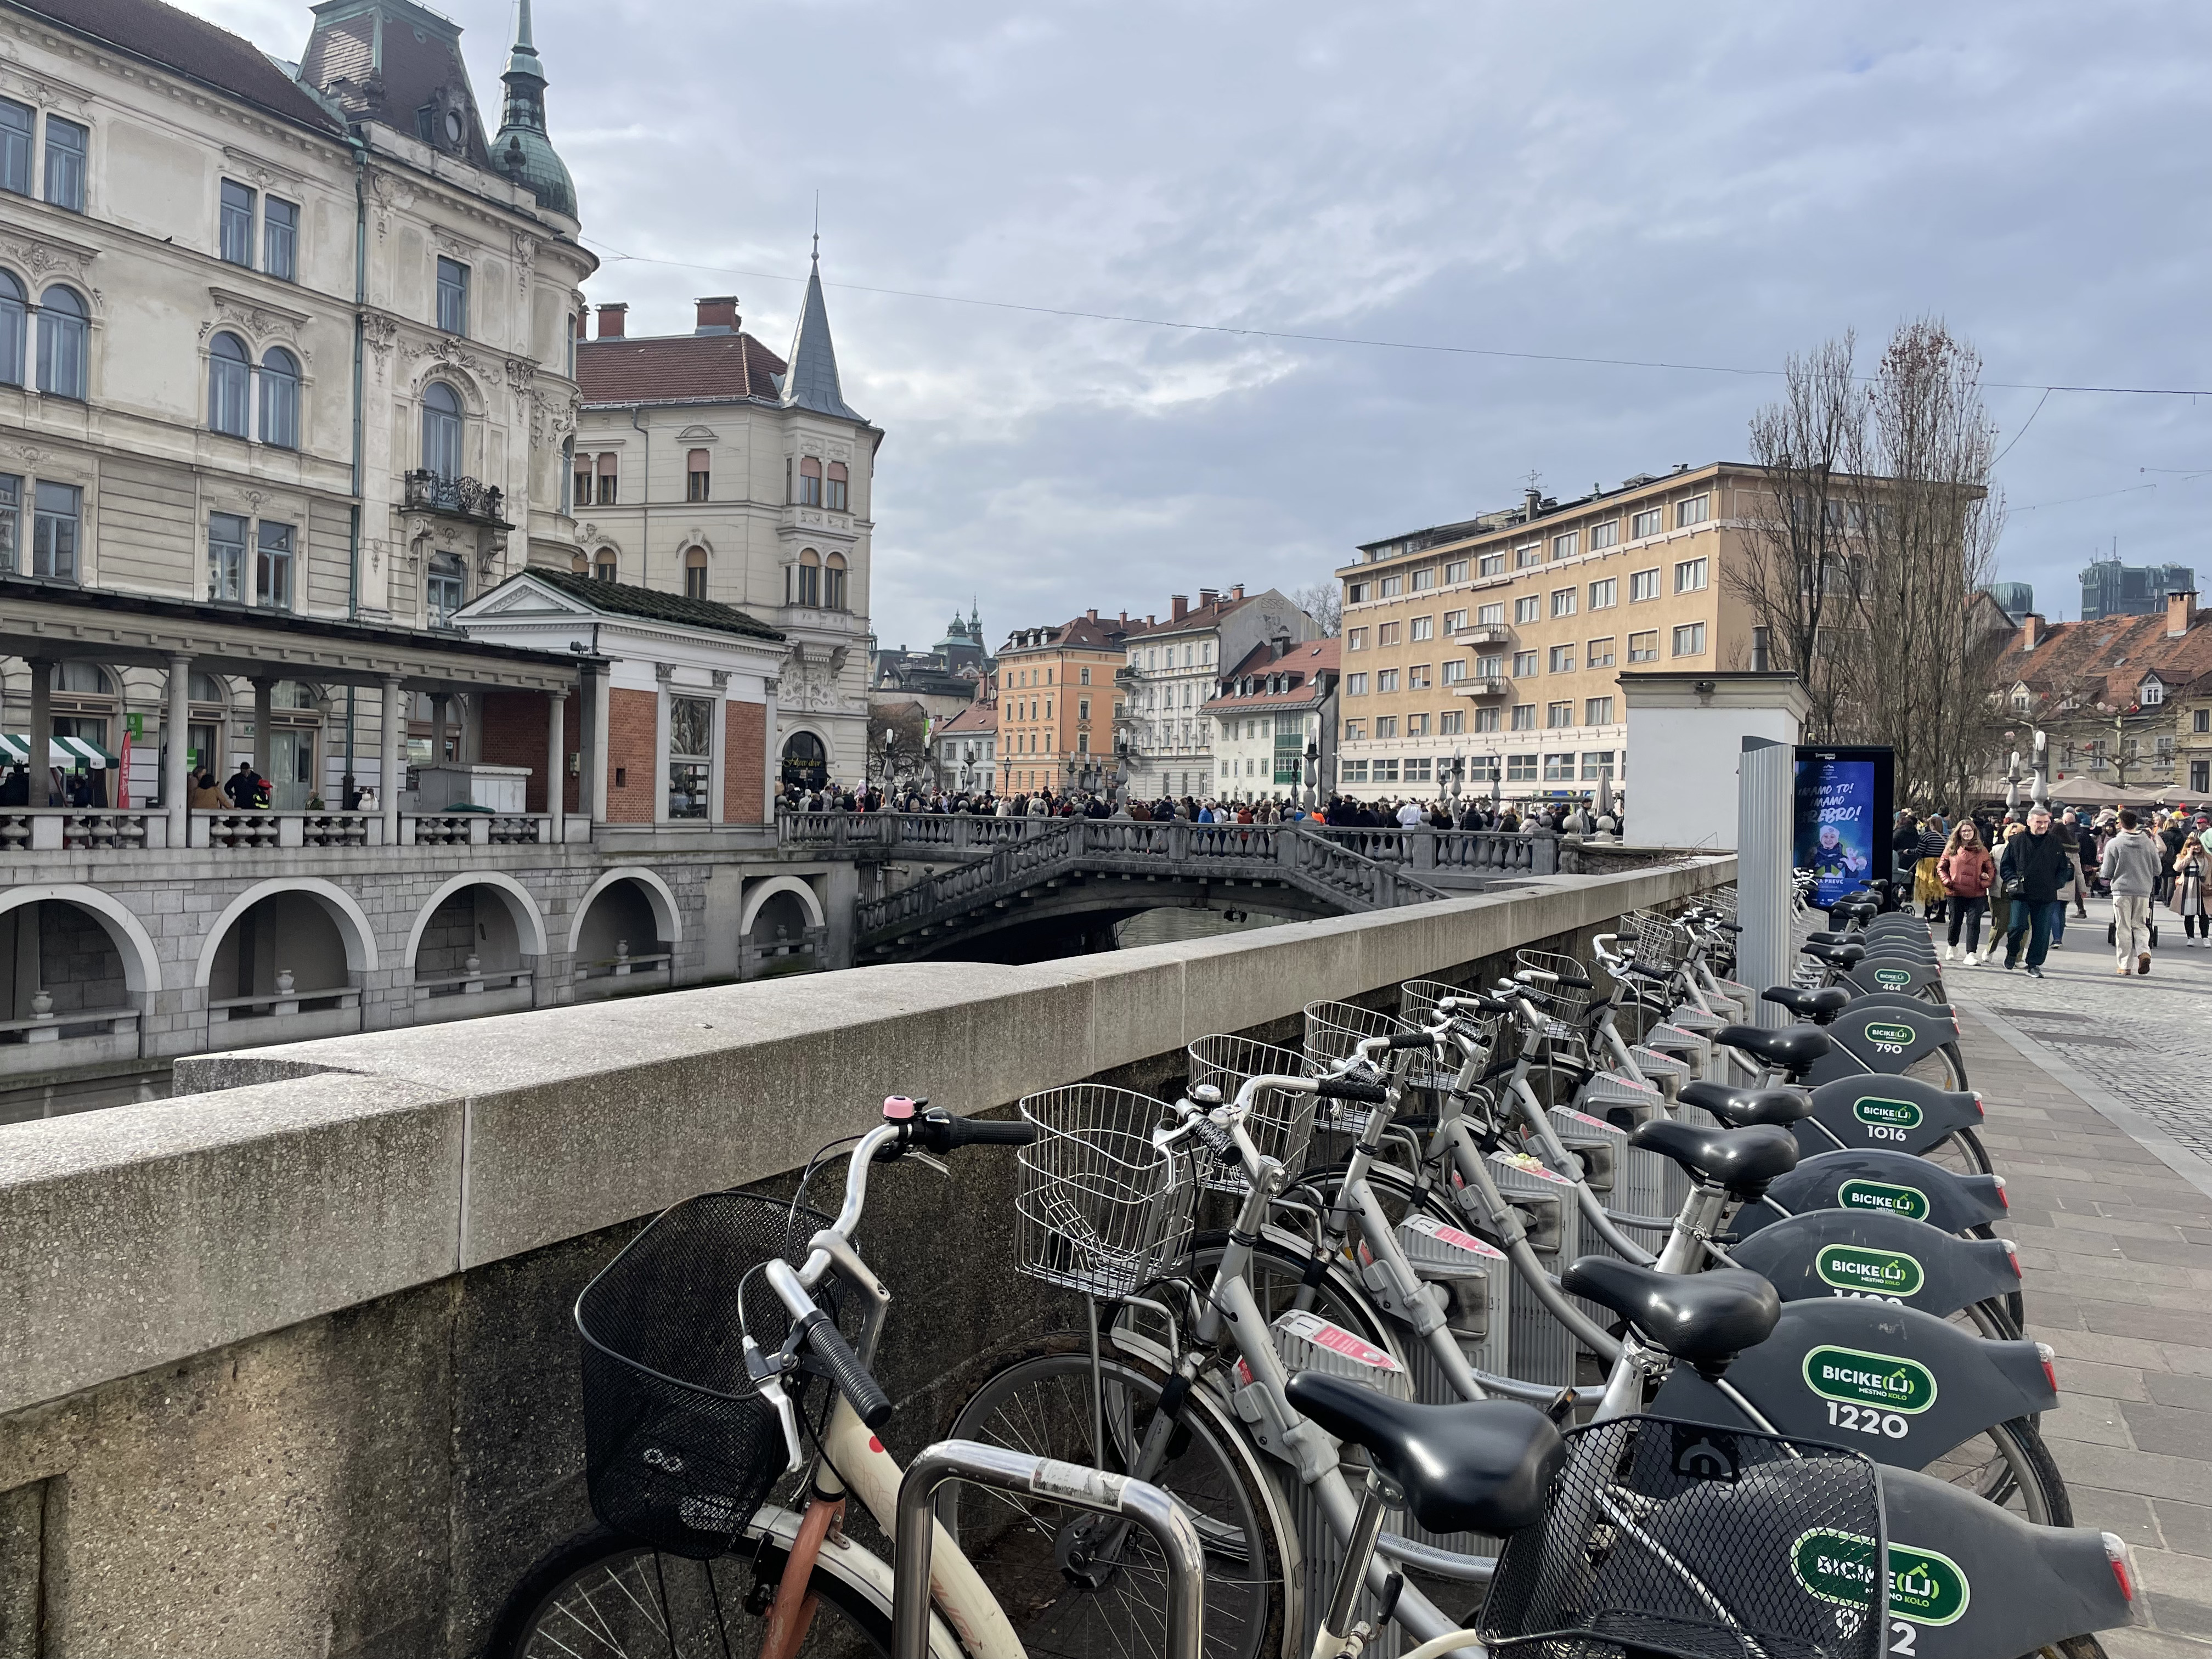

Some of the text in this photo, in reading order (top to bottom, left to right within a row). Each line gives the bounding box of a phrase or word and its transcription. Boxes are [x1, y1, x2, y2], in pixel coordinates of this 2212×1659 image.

[1836, 783, 1854, 794] TO!
[1882, 983, 1901, 991] 464
[1876, 1043, 1903, 1054] 790
[1867, 1125, 1906, 1141] 1016
[1859, 1387, 1908, 1401] MESTNO KOLO
[1827, 1401, 1909, 1438] 1220
[1904, 1595, 1930, 1607] KOLO
[1835, 1607, 1917, 1657] 92
